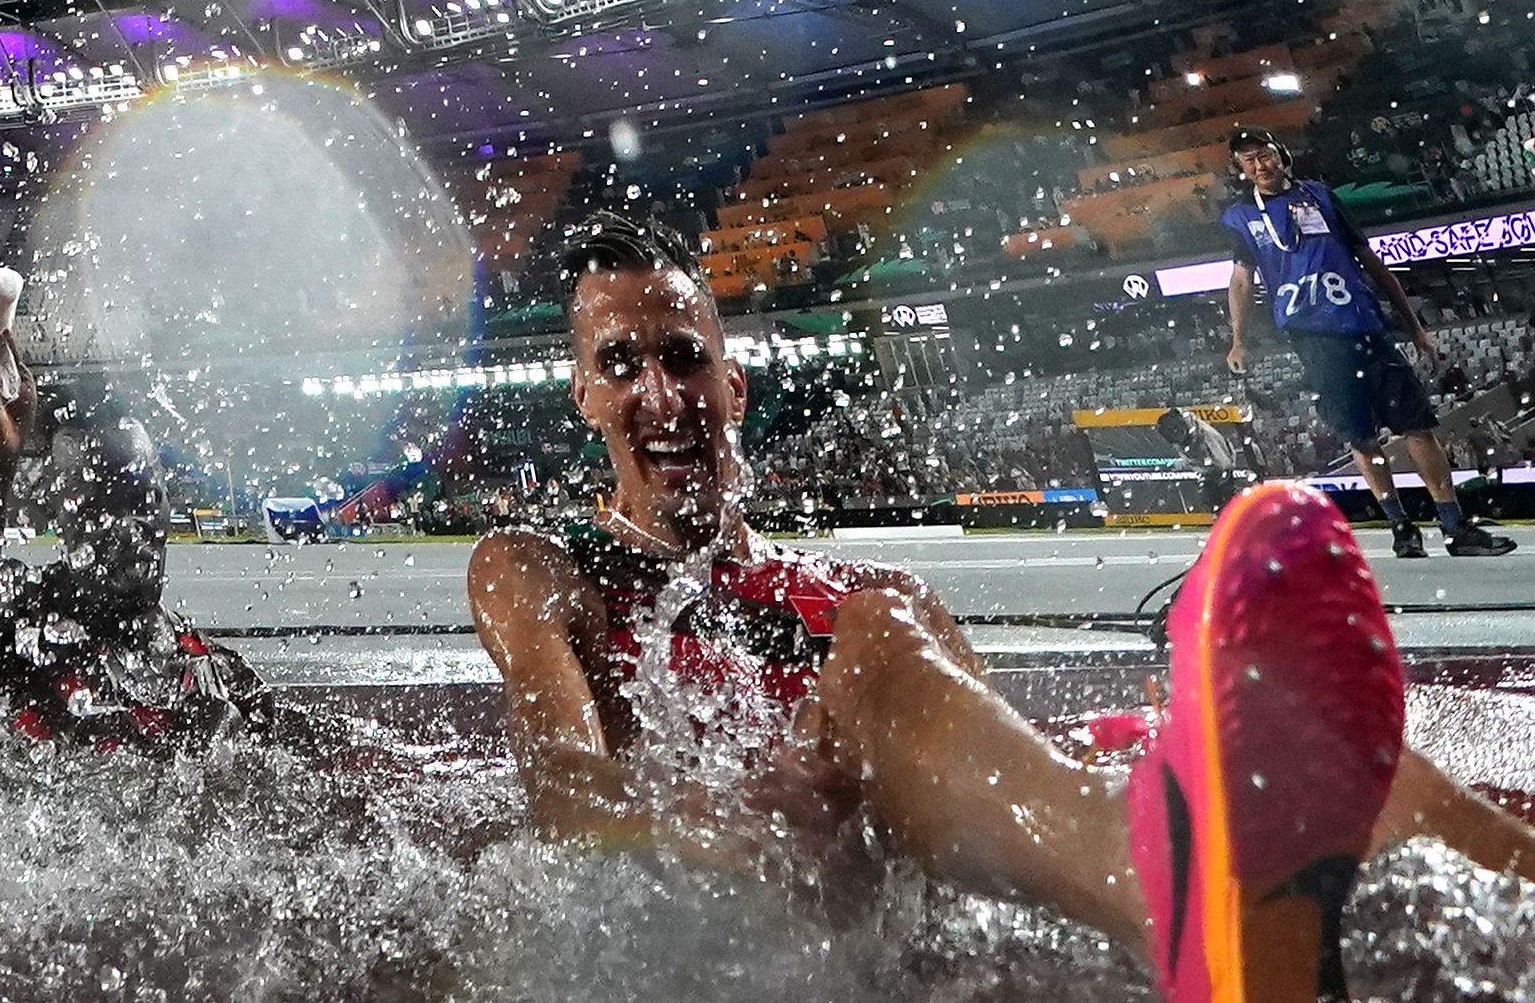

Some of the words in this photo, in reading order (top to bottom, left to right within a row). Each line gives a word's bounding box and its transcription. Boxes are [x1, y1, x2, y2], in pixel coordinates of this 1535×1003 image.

[1376, 233, 1427, 262] AND
[1430, 221, 1494, 254] SAFE
[1276, 272, 1352, 316] 278
